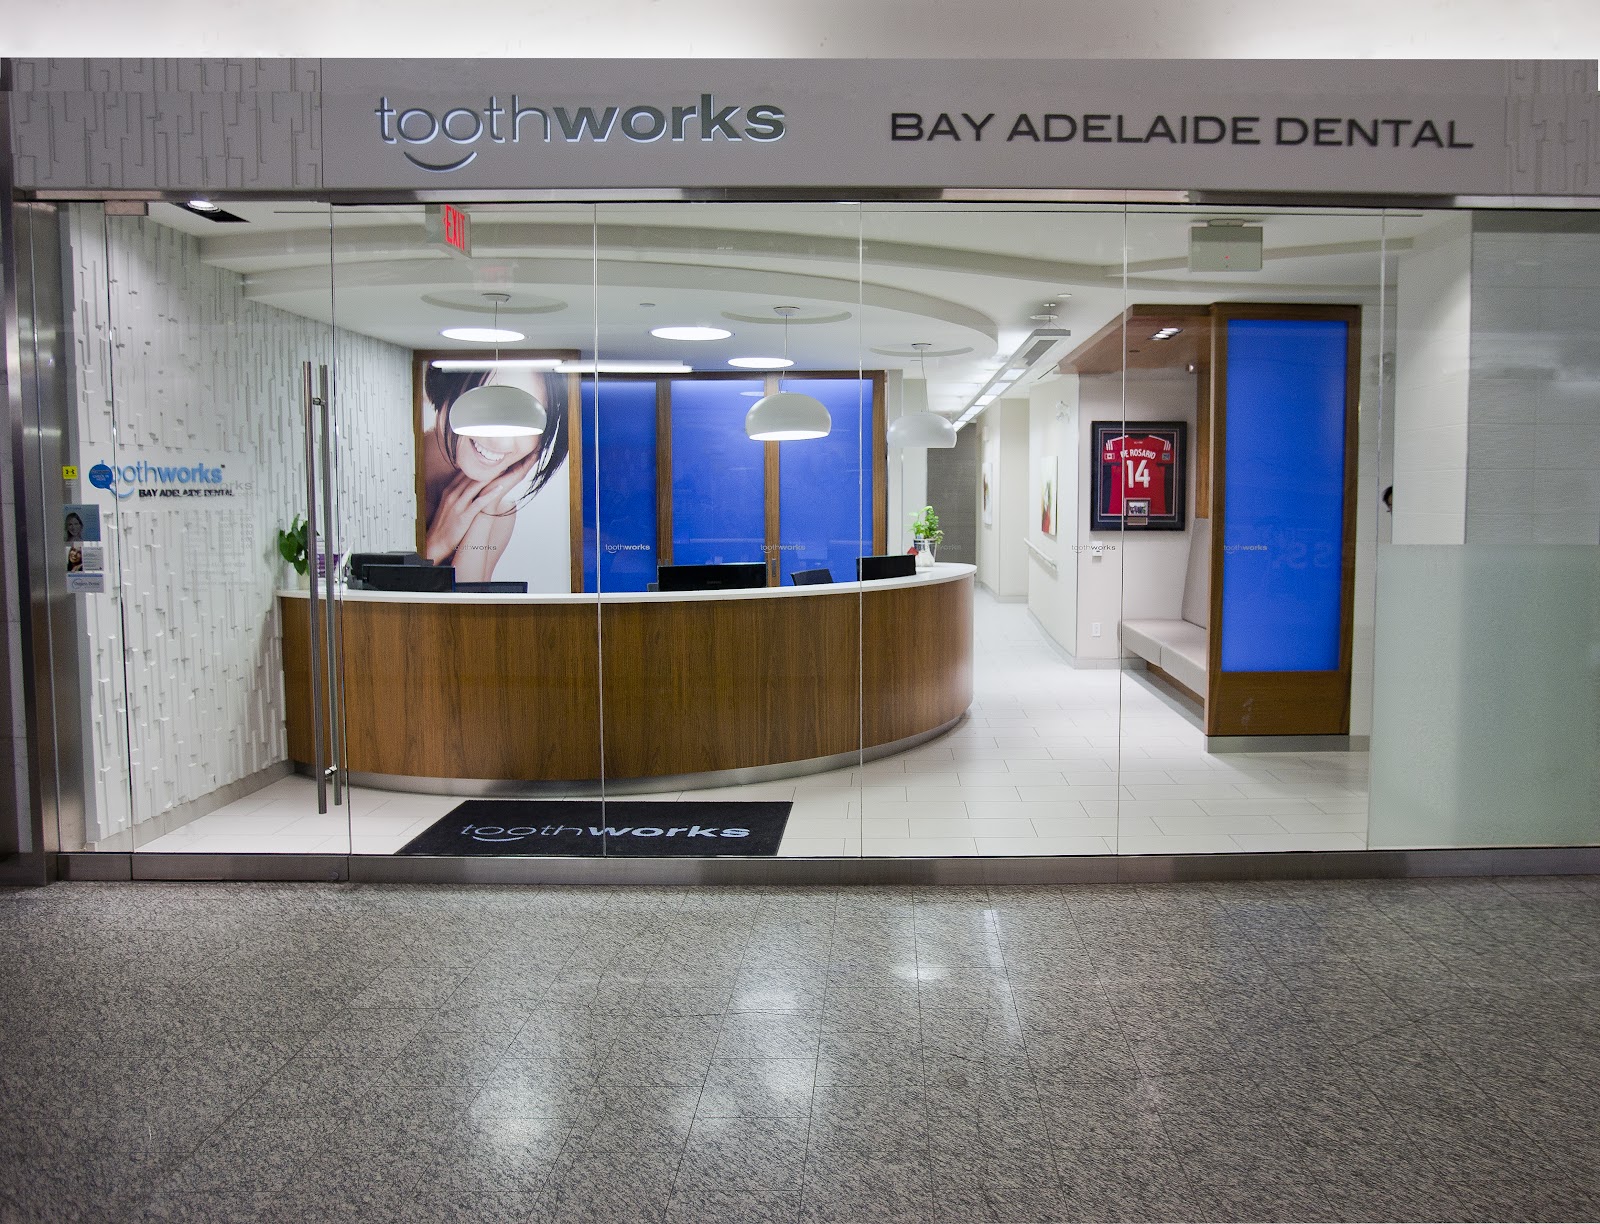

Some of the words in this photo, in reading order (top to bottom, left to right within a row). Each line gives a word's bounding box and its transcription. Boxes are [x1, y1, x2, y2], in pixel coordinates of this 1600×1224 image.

[375, 94, 787, 145] toothworks
[891, 112, 996, 142] BAY
[1006, 114, 1262, 146] ADELAIDE
[1276, 117, 1475, 149] DENTAL
[445, 204, 465, 251] EXIT
[1130, 449, 1156, 460] ROSARIO
[1126, 459, 1151, 489] 14
[138, 488, 158, 498] BAY
[605, 543, 651, 552] toothworks
[760, 543, 806, 552] toothworks
[1071, 544, 1116, 552] toothworks
[460, 823, 751, 839] toothworks
